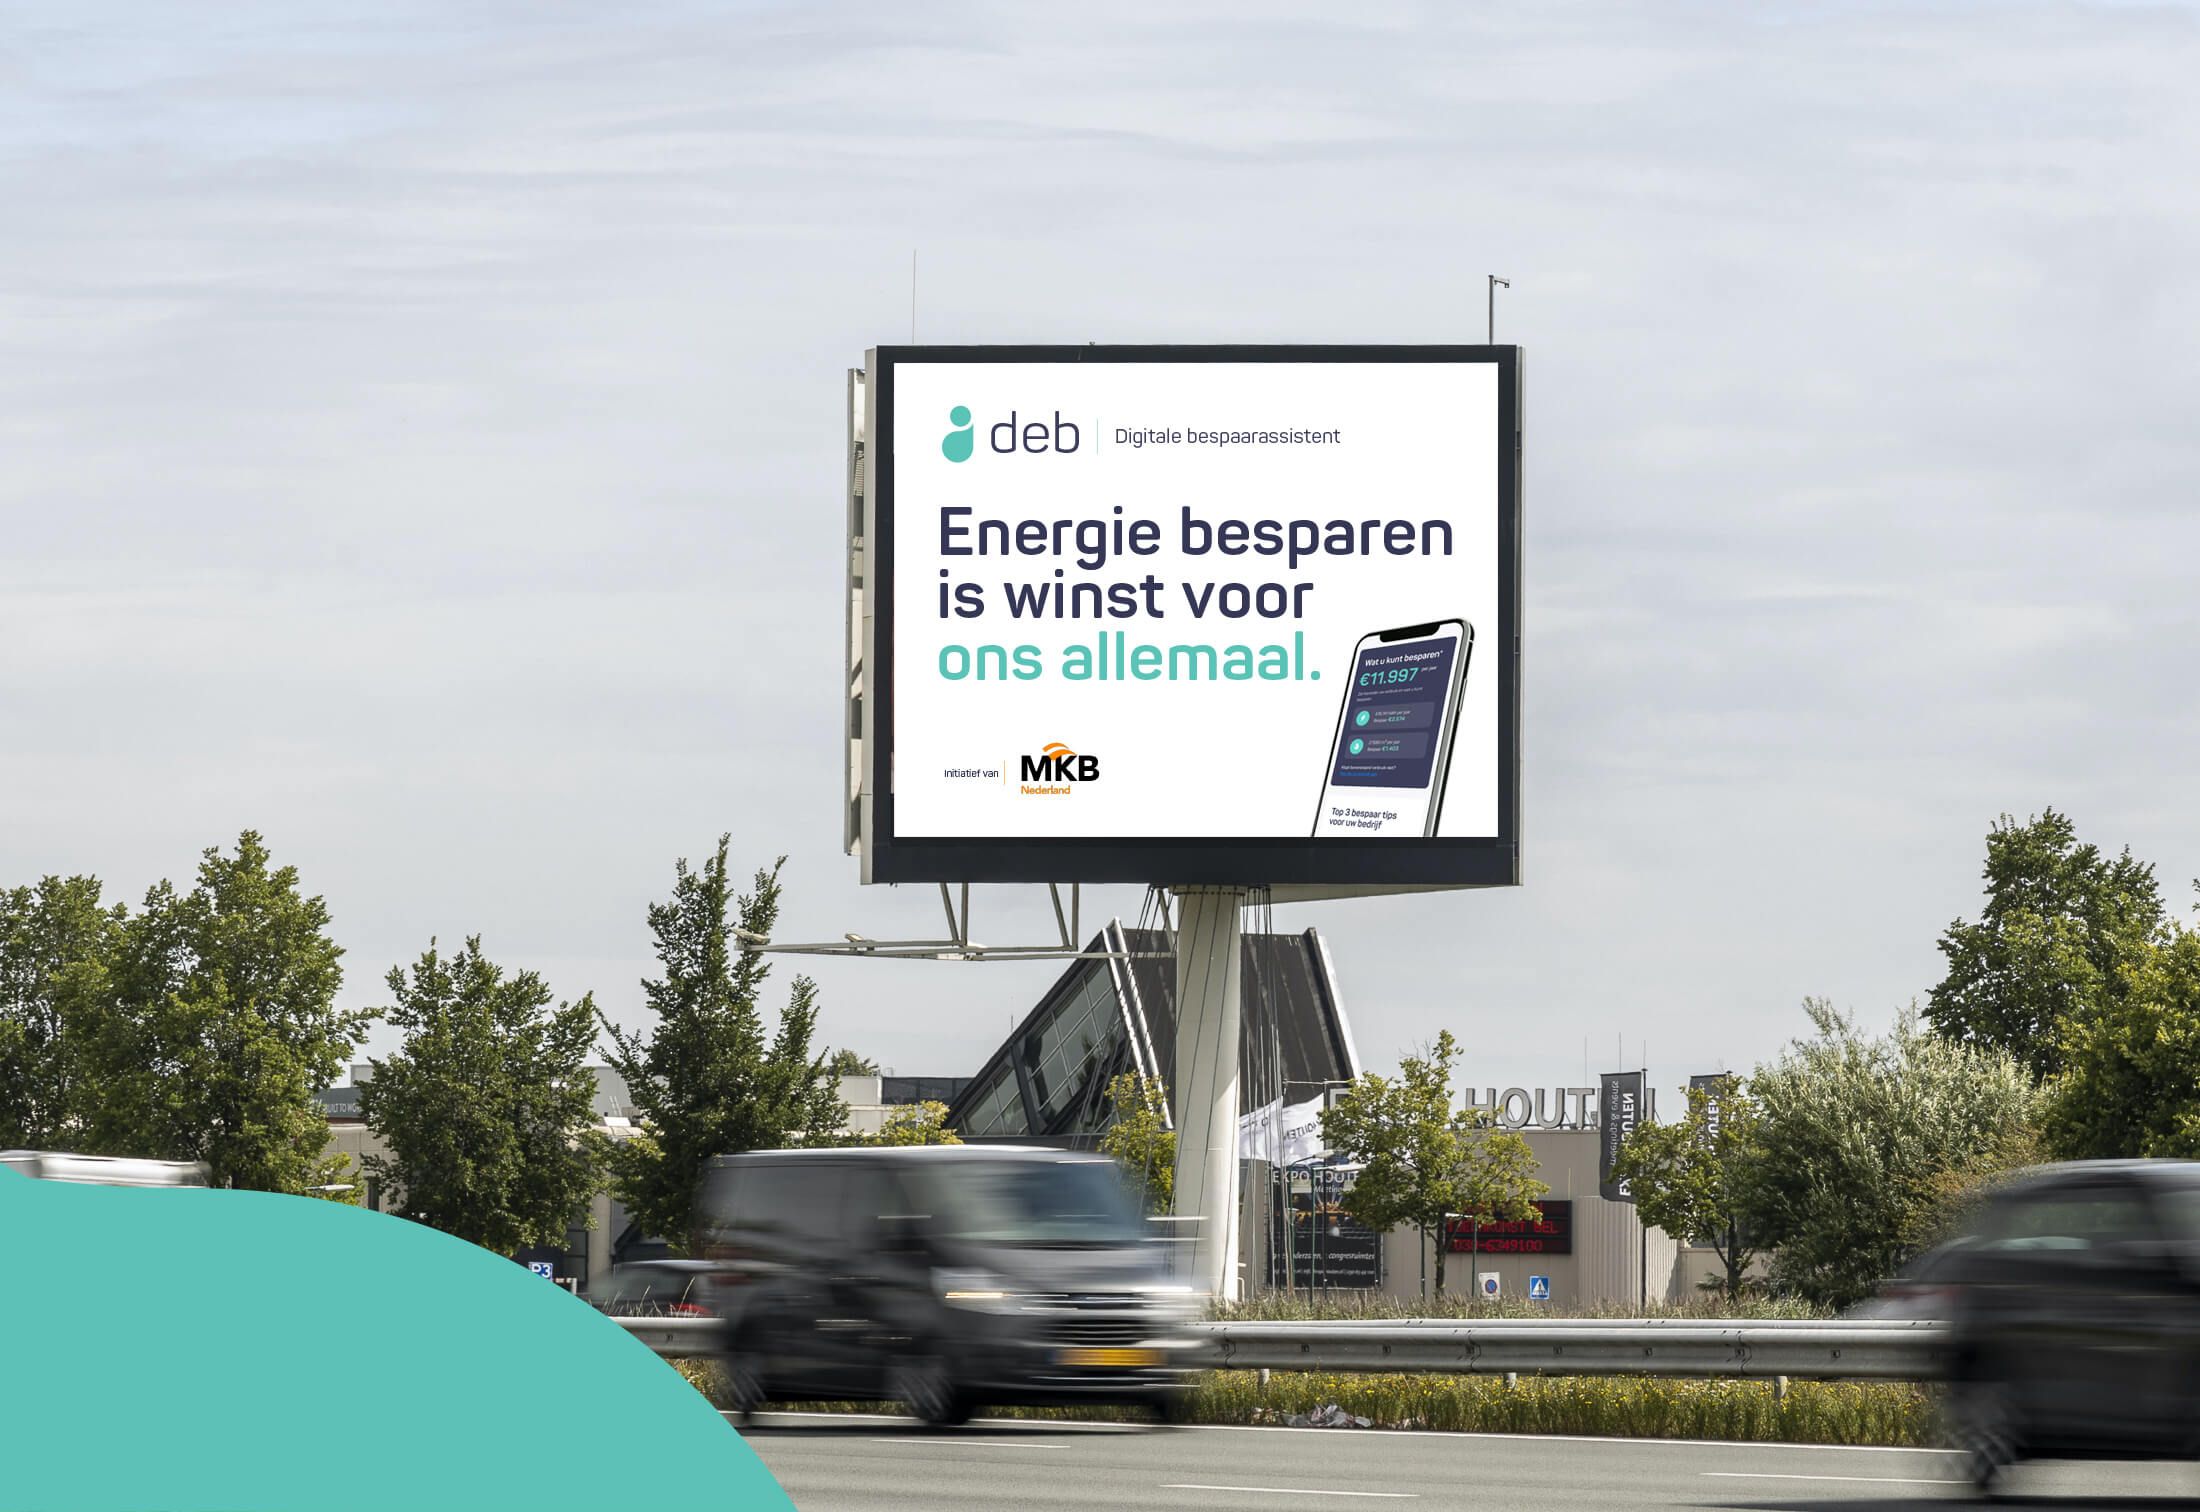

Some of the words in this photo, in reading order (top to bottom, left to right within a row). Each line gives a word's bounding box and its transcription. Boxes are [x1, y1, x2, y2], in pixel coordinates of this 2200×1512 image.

[991, 411, 1079, 453] deb
[1116, 428, 1181, 448] Digitale
[1188, 428, 1340, 447] bespaarassistent
[940, 506, 1160, 570] Energie
[1182, 506, 1452, 569] besparen
[940, 569, 984, 618] is
[1004, 569, 1164, 618] winst
[1182, 583, 1314, 618] voor
[939, 645, 1042, 681] ons
[1062, 631, 1320, 681] allemaal.
[1365, 658, 1379, 667] Wat
[1386, 656, 1403, 665] kunt
[1360, 667, 1419, 686] €11.997
[944, 769, 981, 778] Initiatief
[982, 770, 999, 778] van
[1021, 755, 1100, 782] MKB
[1020, 785, 1071, 795] Nederland
[1331, 807, 1344, 817] Top
[1345, 808, 1351, 817] 3
[1351, 808, 1381, 819] bespaar
[1382, 811, 1398, 820] tips
[1329, 818, 1345, 826] voor
[1357, 819, 1383, 831] bedrijf
[1466, 1088, 1655, 1129] HOUT
[1273, 1170, 1309, 1184] EXPO
[1313, 1170, 1358, 1184] HOUTE
[531, 1263, 551, 1278] P3
